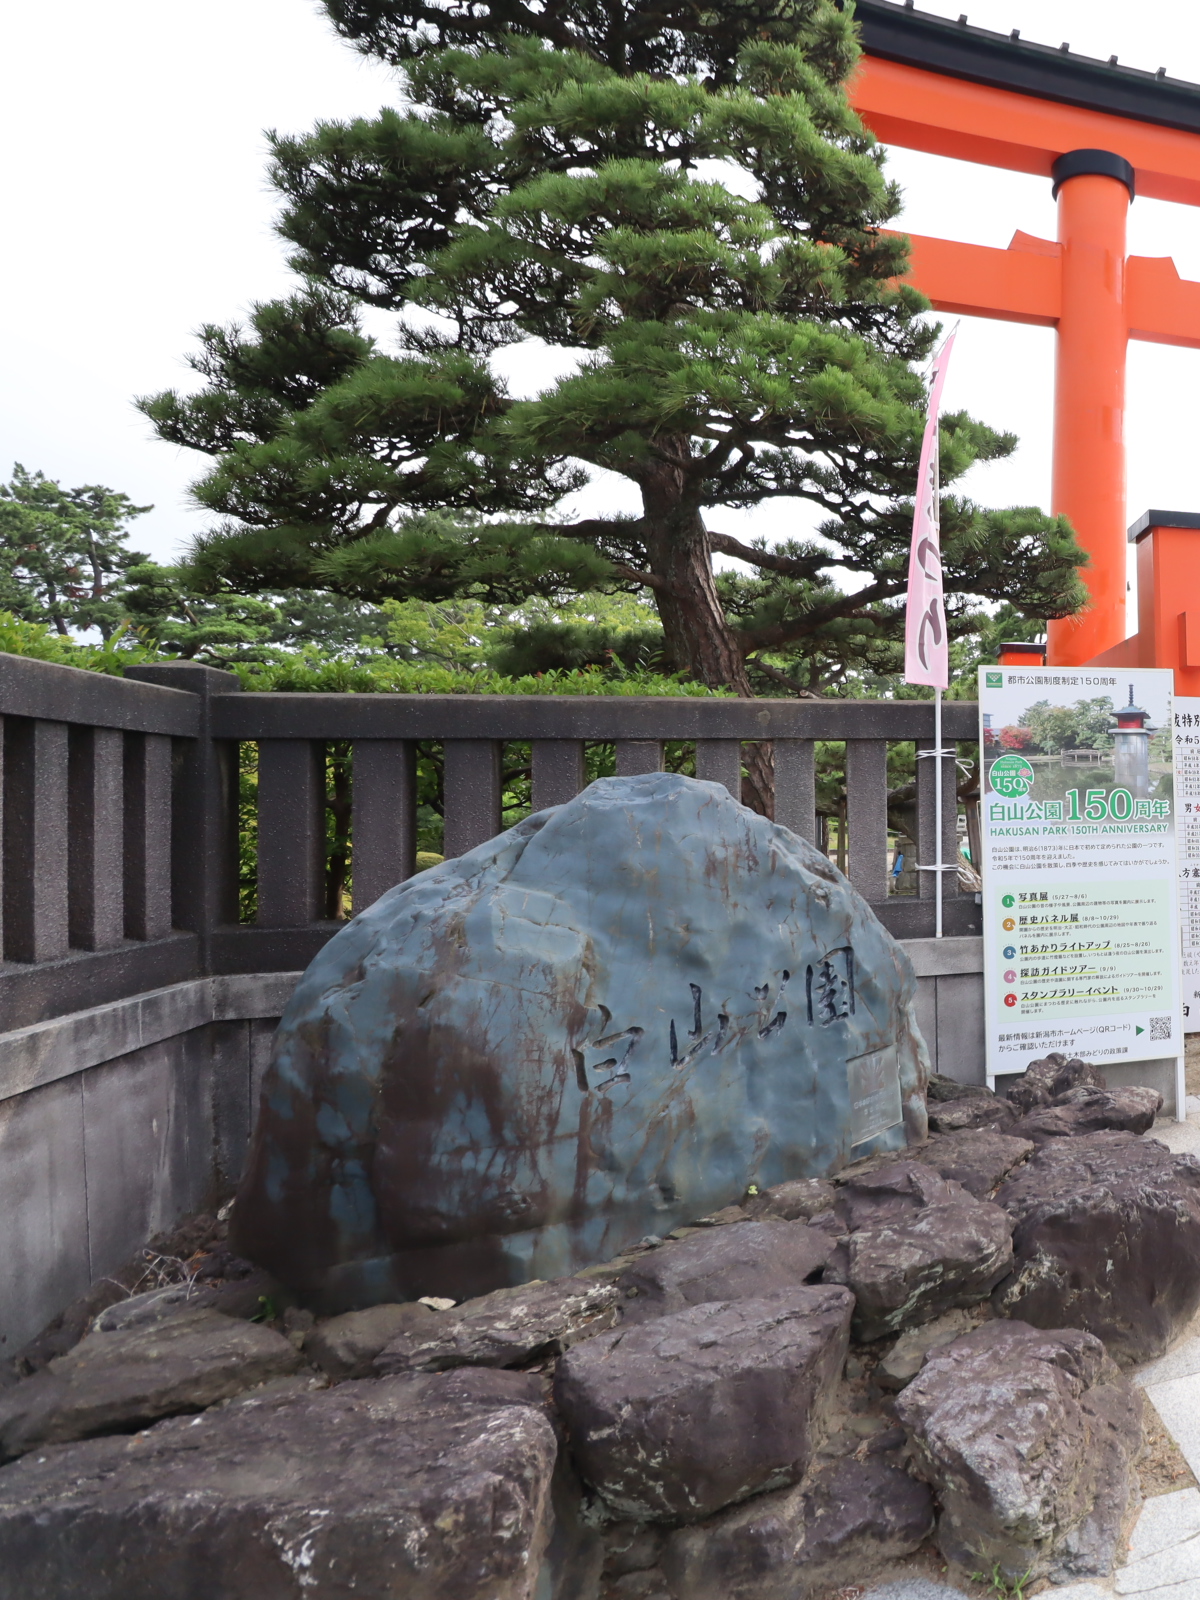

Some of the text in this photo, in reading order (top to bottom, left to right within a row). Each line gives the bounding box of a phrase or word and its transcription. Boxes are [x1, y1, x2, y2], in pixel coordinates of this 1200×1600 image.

[1007, 675, 1118, 686] 都市公園制度制定150周年
[989, 788, 1170, 821] 白山公園150周年
[990, 823, 1168, 836] HAKUSAN PARK 150TH ANNIVERSARY
[1018, 892, 1049, 902] 写真展
[1019, 913, 1079, 925] 歴史パネル展
[1020, 940, 1111, 954] 竹あかりライトアップ
[1020, 965, 1096, 978] 探訪ガイドツアー
[1021, 986, 1119, 1001] スタンプラリーイベント
[572, 945, 856, 1092] 白山公園
[998, 1023, 1131, 1042] 最新情報は新潟市ホームページ(QRコード)
[998, 1038, 1076, 1053] からご確認いただけます
